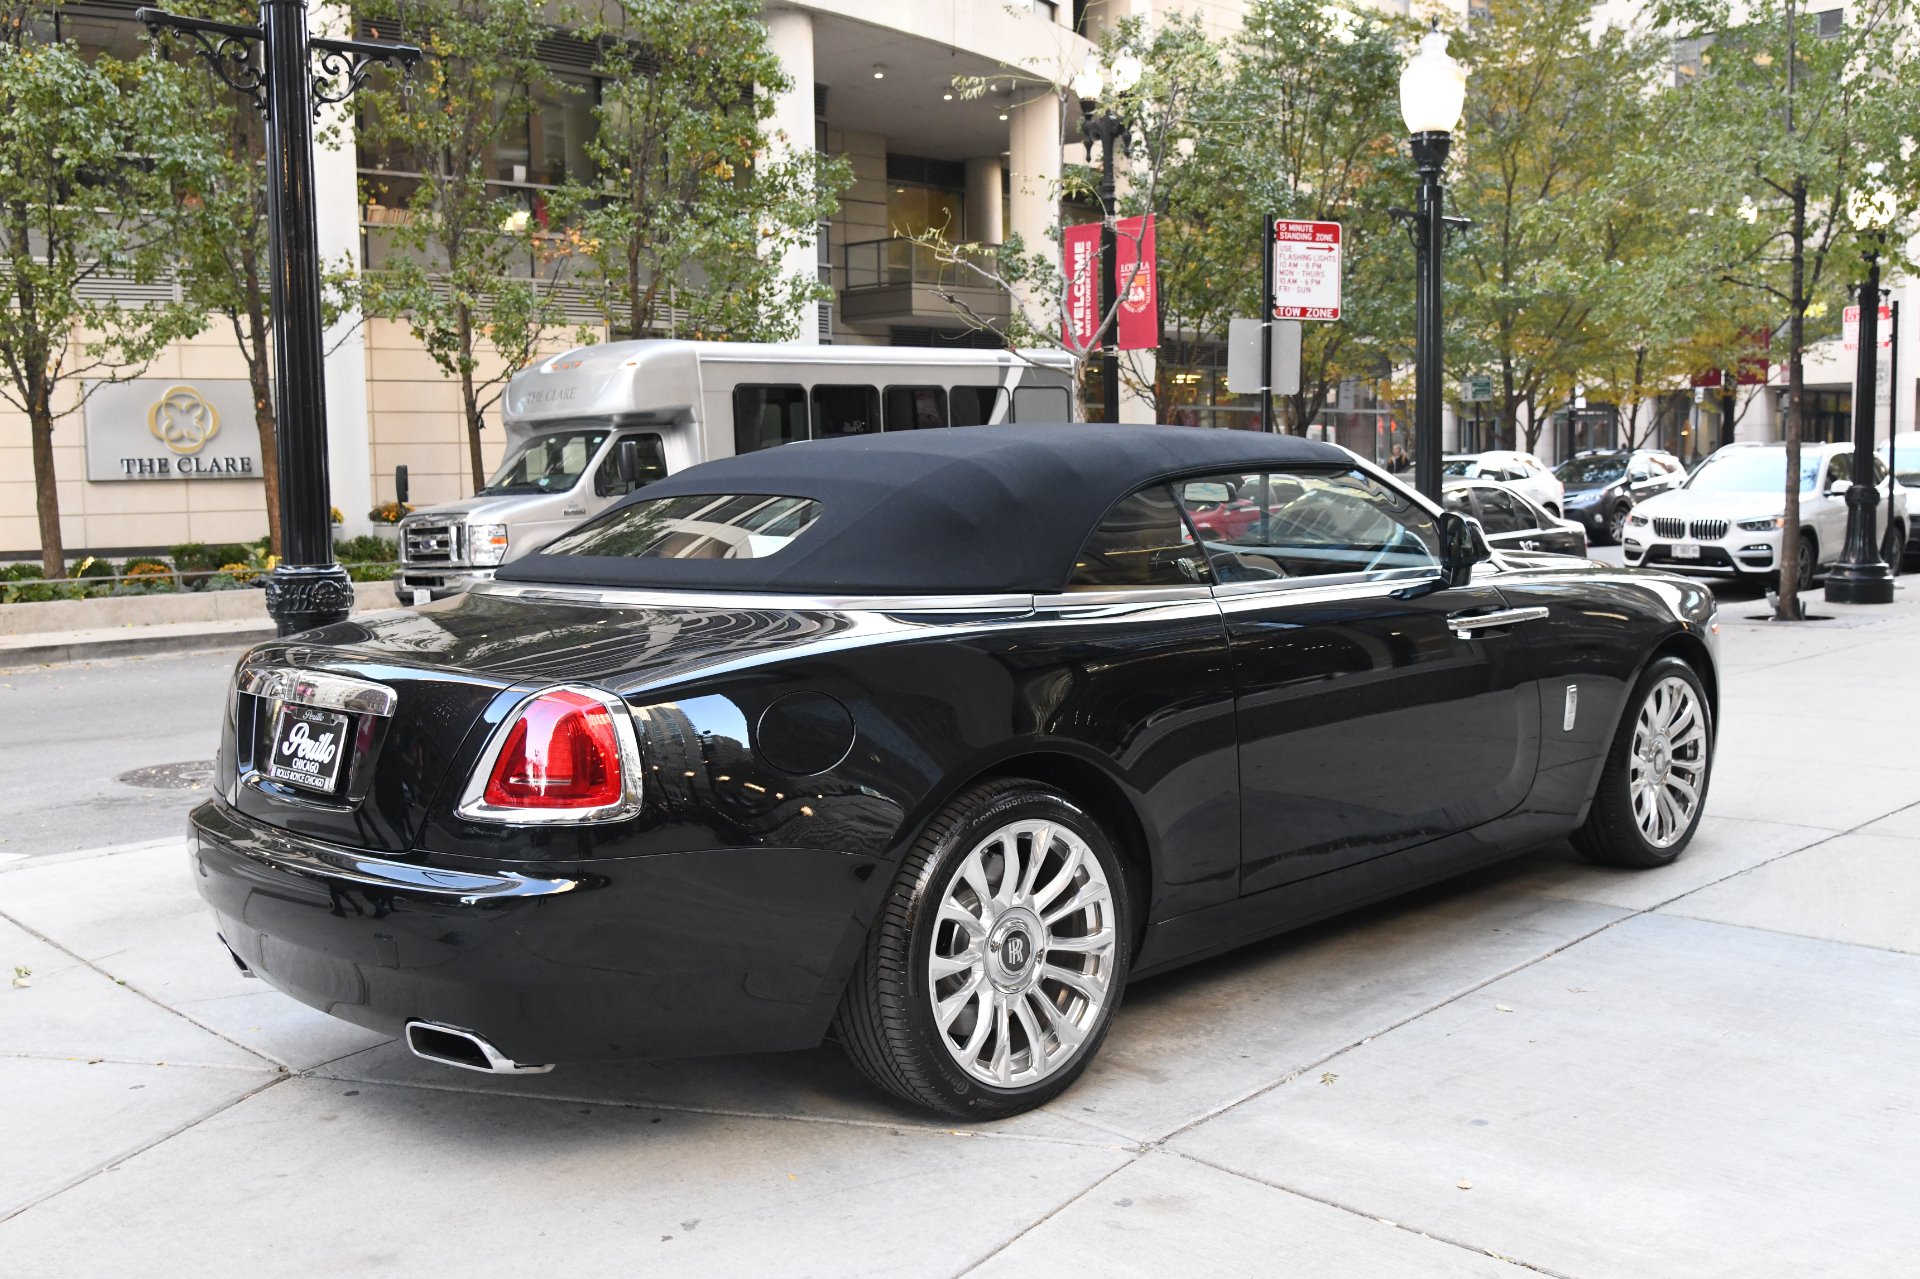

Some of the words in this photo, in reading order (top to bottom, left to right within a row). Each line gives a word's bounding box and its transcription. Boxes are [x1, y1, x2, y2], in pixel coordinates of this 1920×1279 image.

[1289, 224, 1314, 232] MINUTE
[1280, 232, 1312, 240] STANDING
[1315, 233, 1333, 242] ZONE
[1120, 261, 1150, 271] LOLA
[1302, 270, 1325, 278] THURS
[1074, 241, 1085, 336] WELCOME
[1280, 307, 1301, 317] TOW
[1306, 308, 1333, 318] ZONE
[527, 391, 544, 404] THE
[545, 387, 577, 401] CLARE
[121, 458, 170, 475] THE
[177, 457, 252, 474] CLARE
[282, 722, 335, 763] Perillo
[292, 757, 320, 774] CHICAGO
[276, 768, 291, 779] ROLLS
[305, 775, 325, 787] CHICAGO
